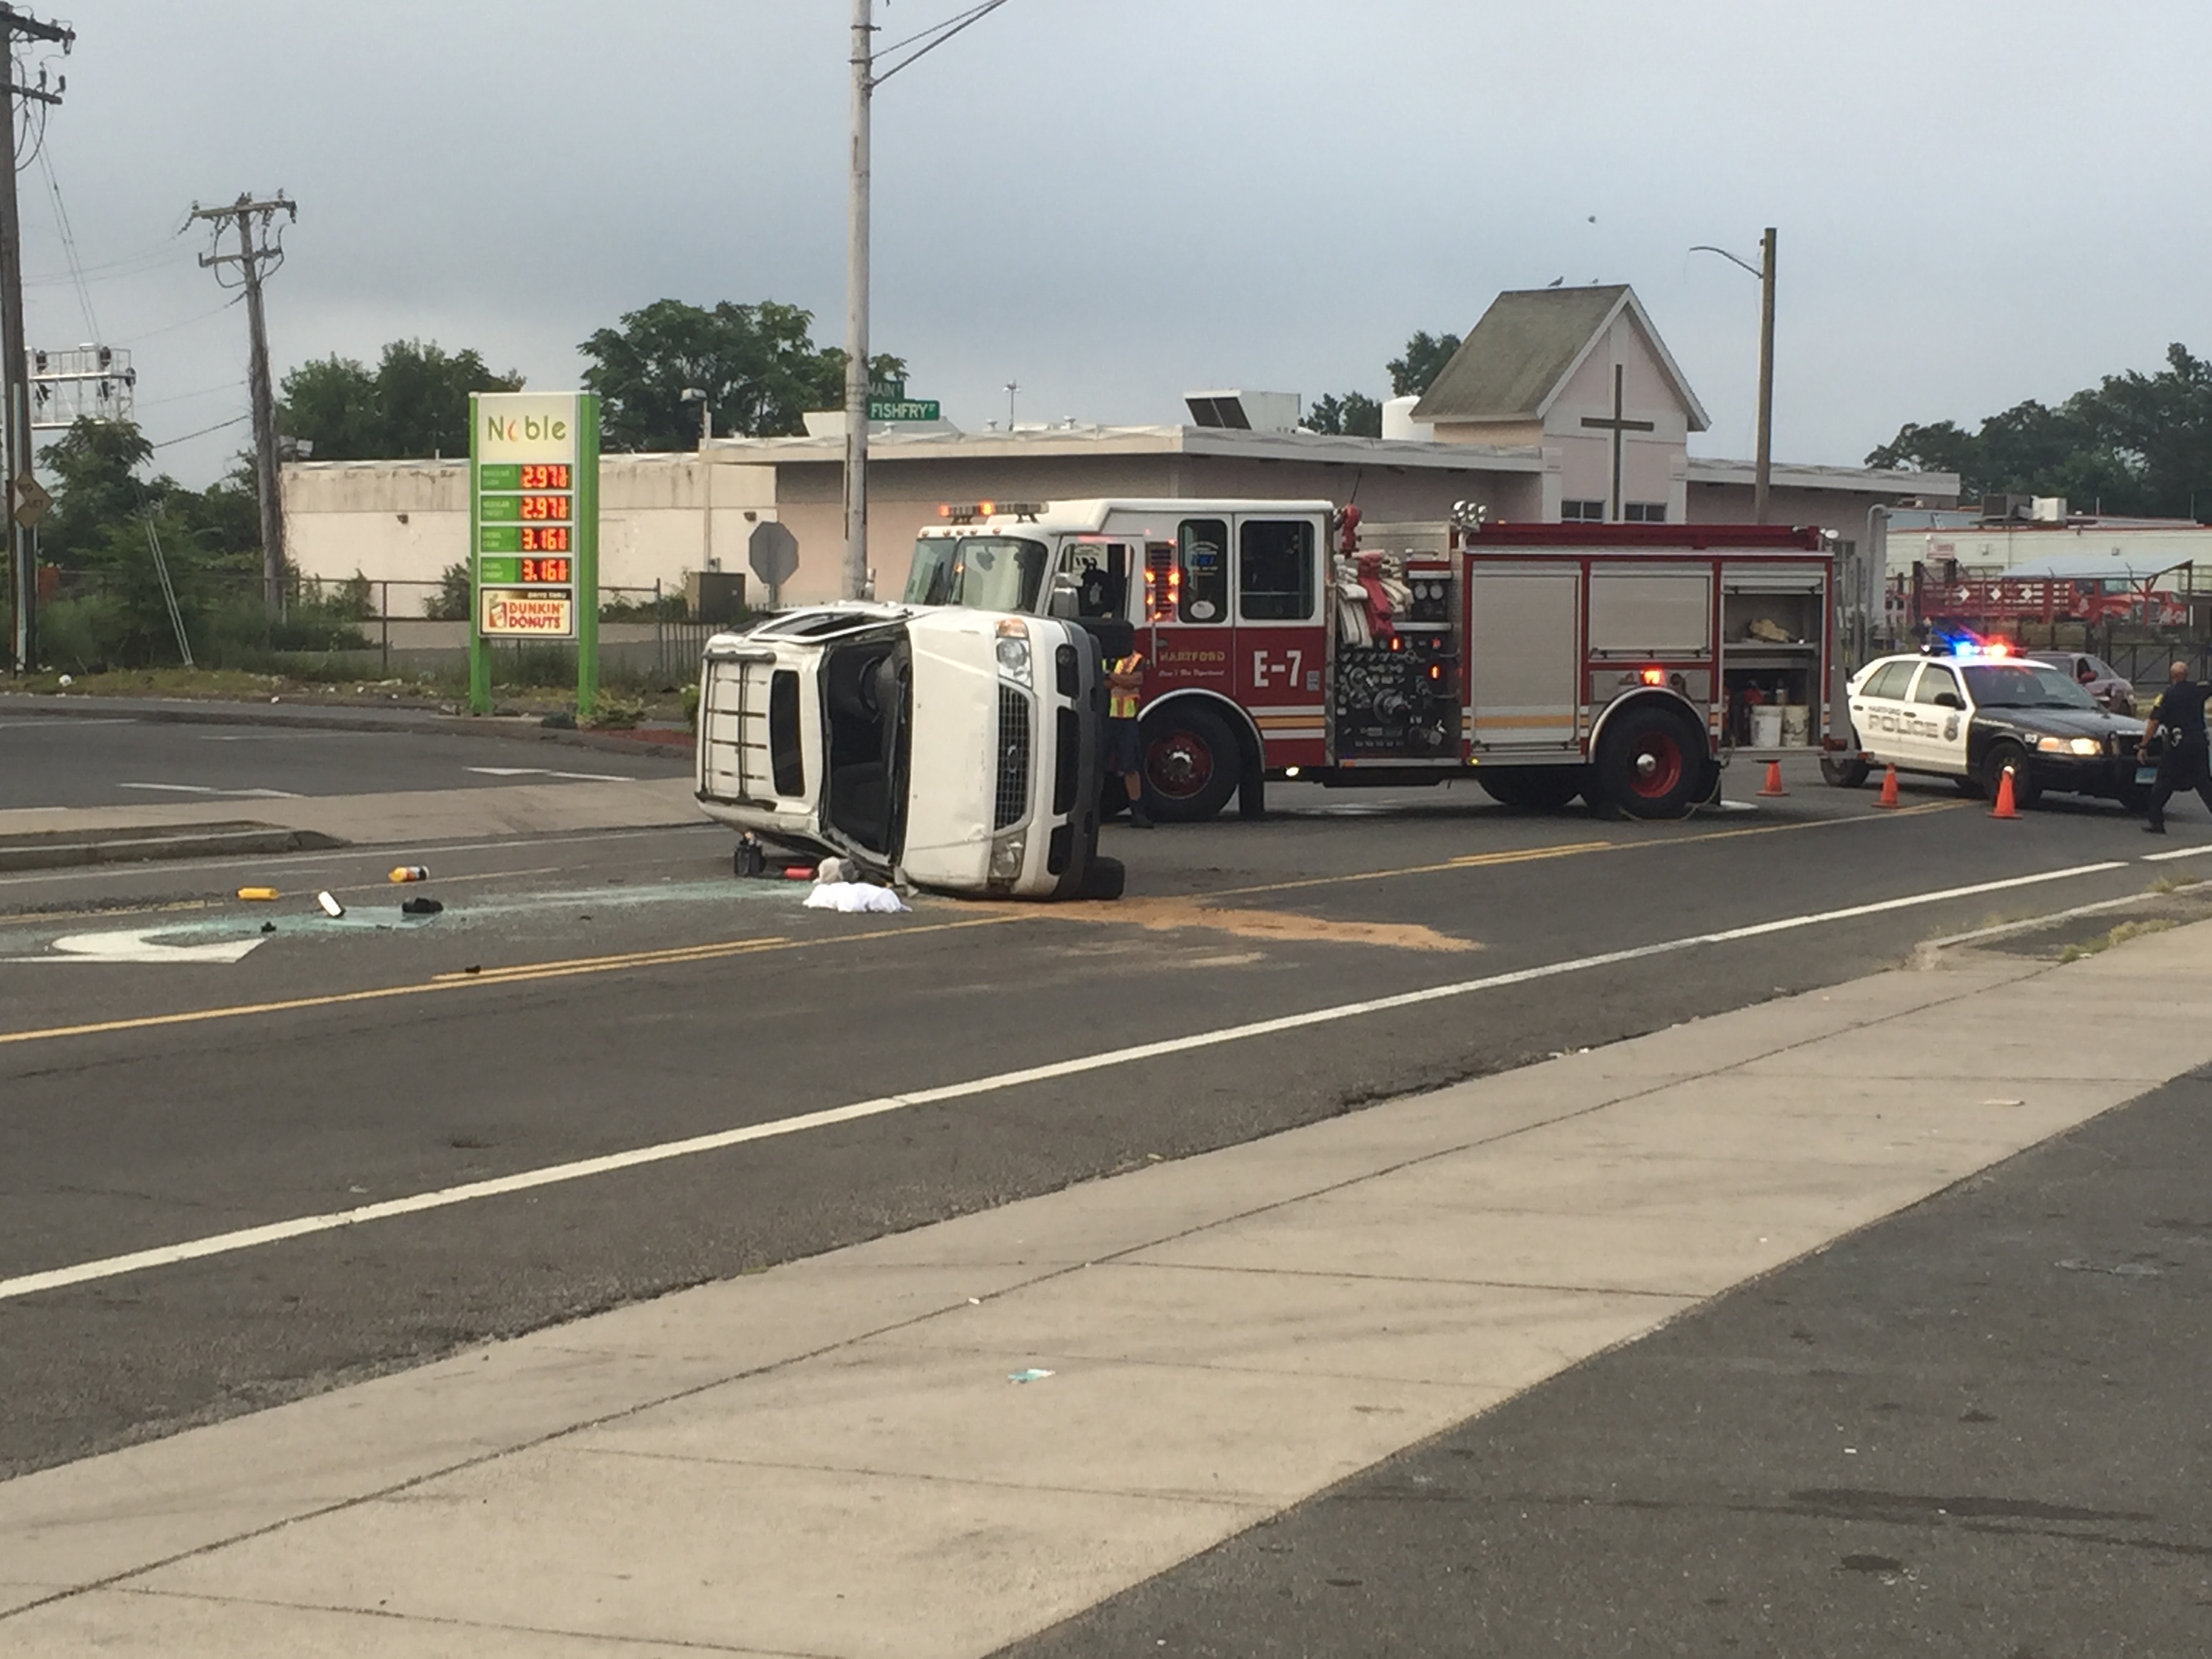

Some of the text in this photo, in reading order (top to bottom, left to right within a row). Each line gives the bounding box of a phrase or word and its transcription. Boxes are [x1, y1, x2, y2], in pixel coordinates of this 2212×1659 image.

[871, 403, 927, 418] FISHFRY
[508, 602, 564, 614] DUNKIN'
[508, 615, 561, 629] DONUTS
[1160, 651, 1226, 662] HARTFORD
[1254, 651, 1301, 687] E-7
[1868, 714, 1939, 739] POLICE
